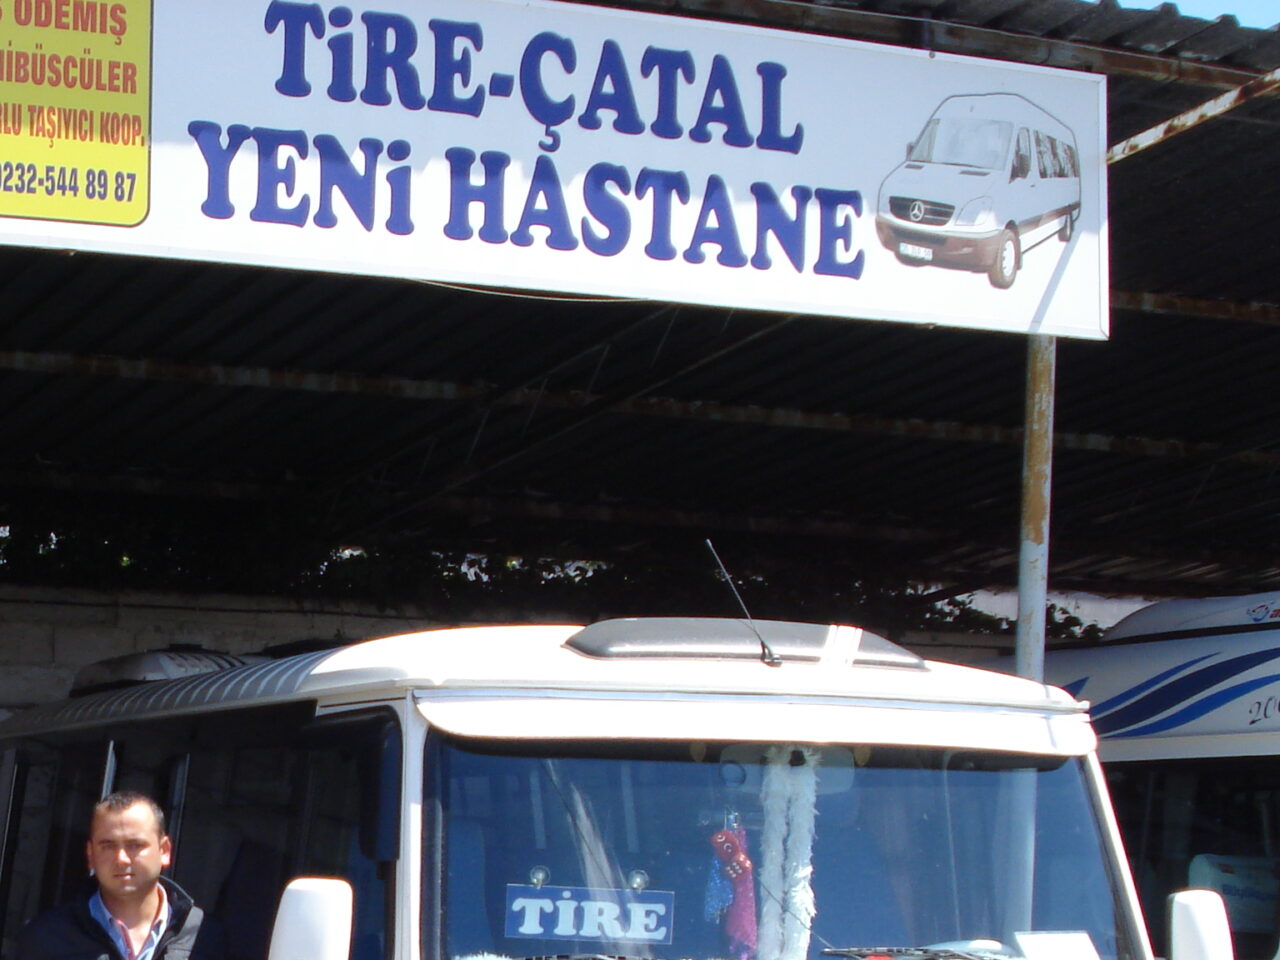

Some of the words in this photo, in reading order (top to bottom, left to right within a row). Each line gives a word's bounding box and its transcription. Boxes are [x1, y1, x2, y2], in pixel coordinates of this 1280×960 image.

[27, 104, 95, 149] TAŞIYICI
[99, 111, 145, 147] KOOP.
[85, 168, 108, 201] 89
[114, 170, 136, 203] 87
[443, 146, 866, 281] HASTANE
